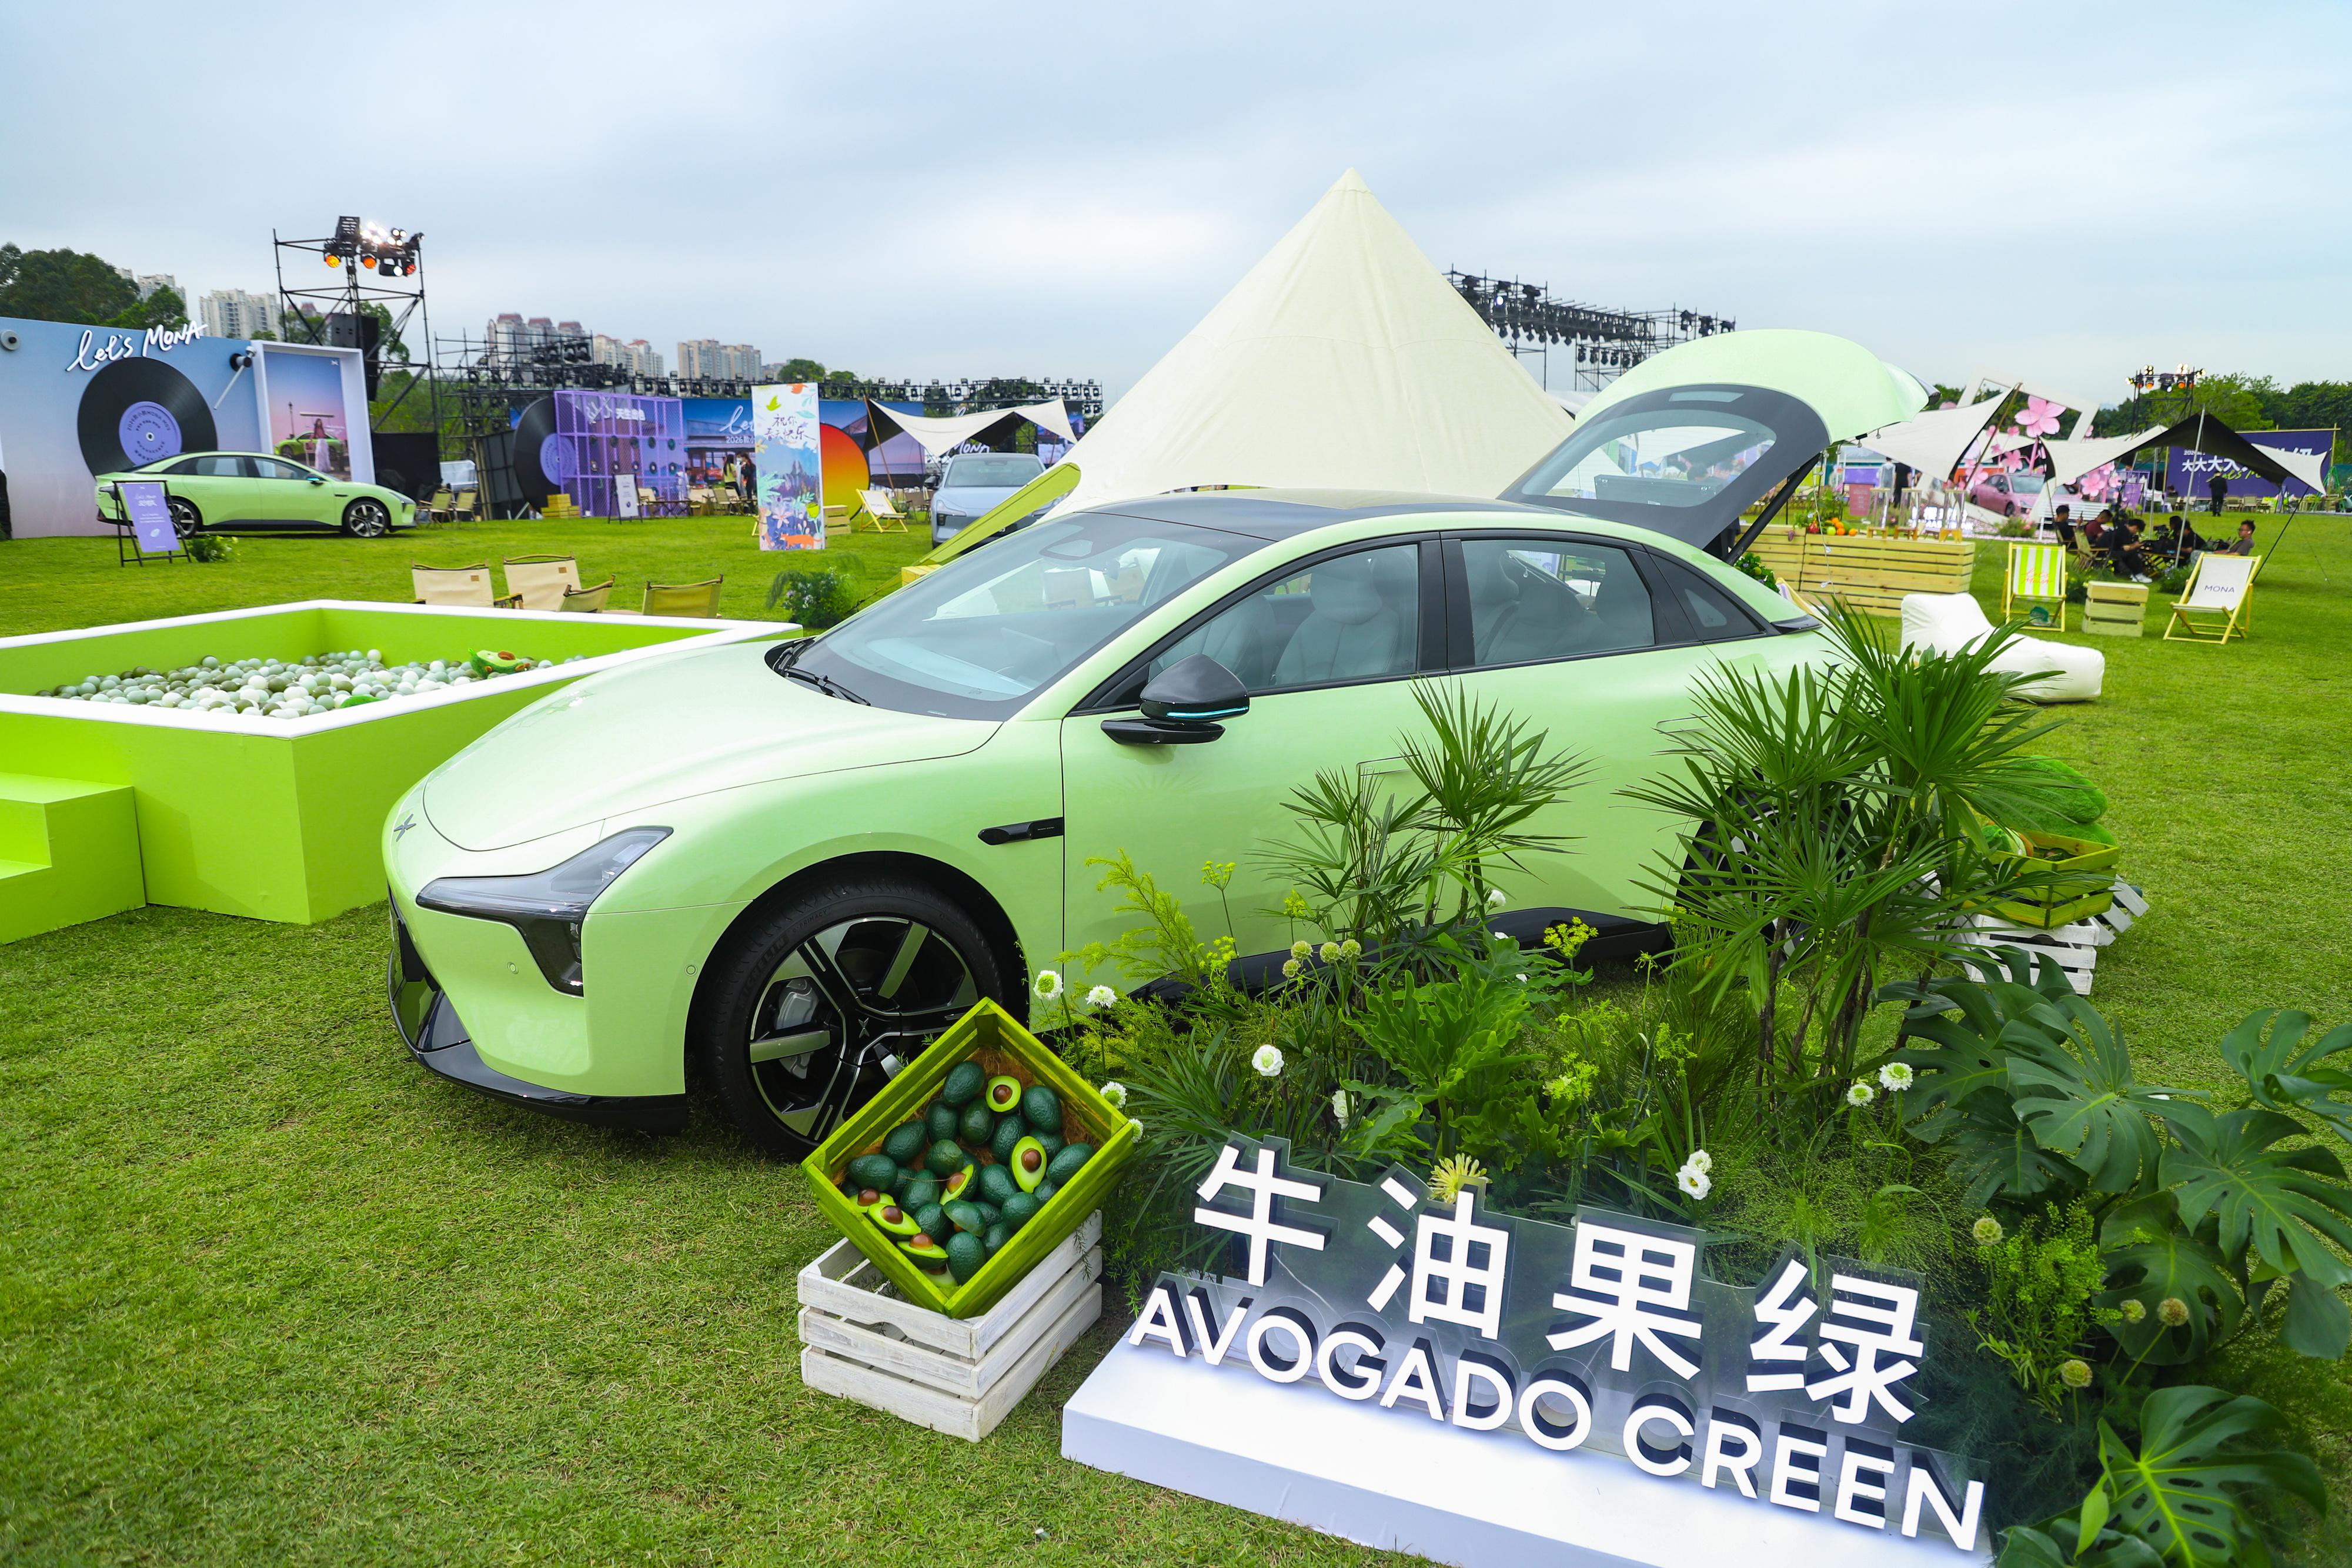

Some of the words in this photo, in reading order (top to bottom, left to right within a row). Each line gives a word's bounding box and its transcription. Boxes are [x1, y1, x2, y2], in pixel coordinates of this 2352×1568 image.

[772, 414, 797, 427] 祝你
[1194, 1144, 1925, 1425] 牛油果绿
[1128, 1285, 1592, 1452] AVOGADO
[1622, 1404, 1986, 1552] CREEN
